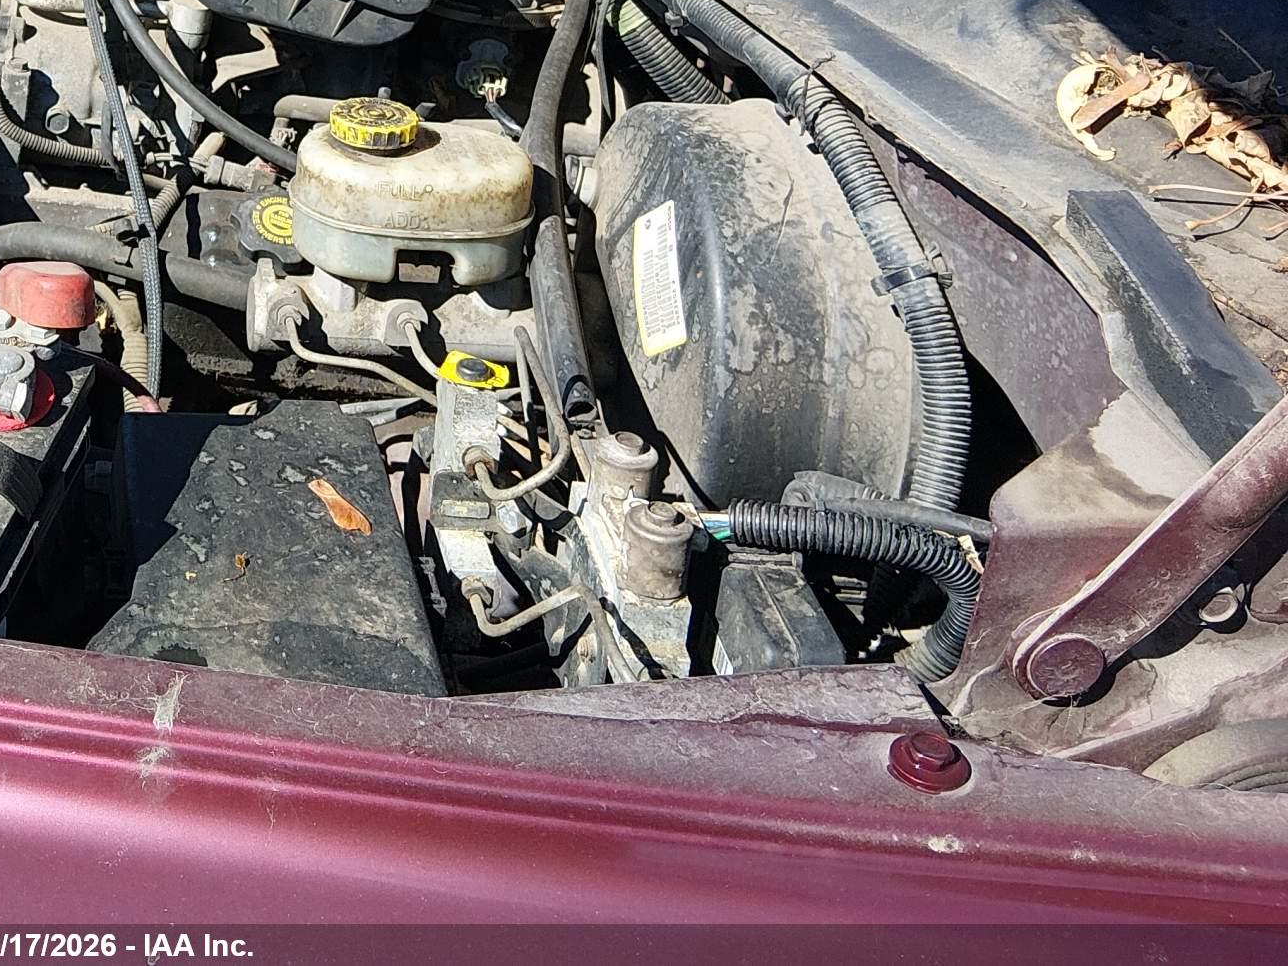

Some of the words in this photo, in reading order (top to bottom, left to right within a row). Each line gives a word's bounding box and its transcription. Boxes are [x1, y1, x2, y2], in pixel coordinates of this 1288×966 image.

[378, 181, 423, 202] FULL
[260, 196, 288, 207] ENGINE
[385, 211, 420, 230] ADD
[256, 224, 284, 244] OWNERS
